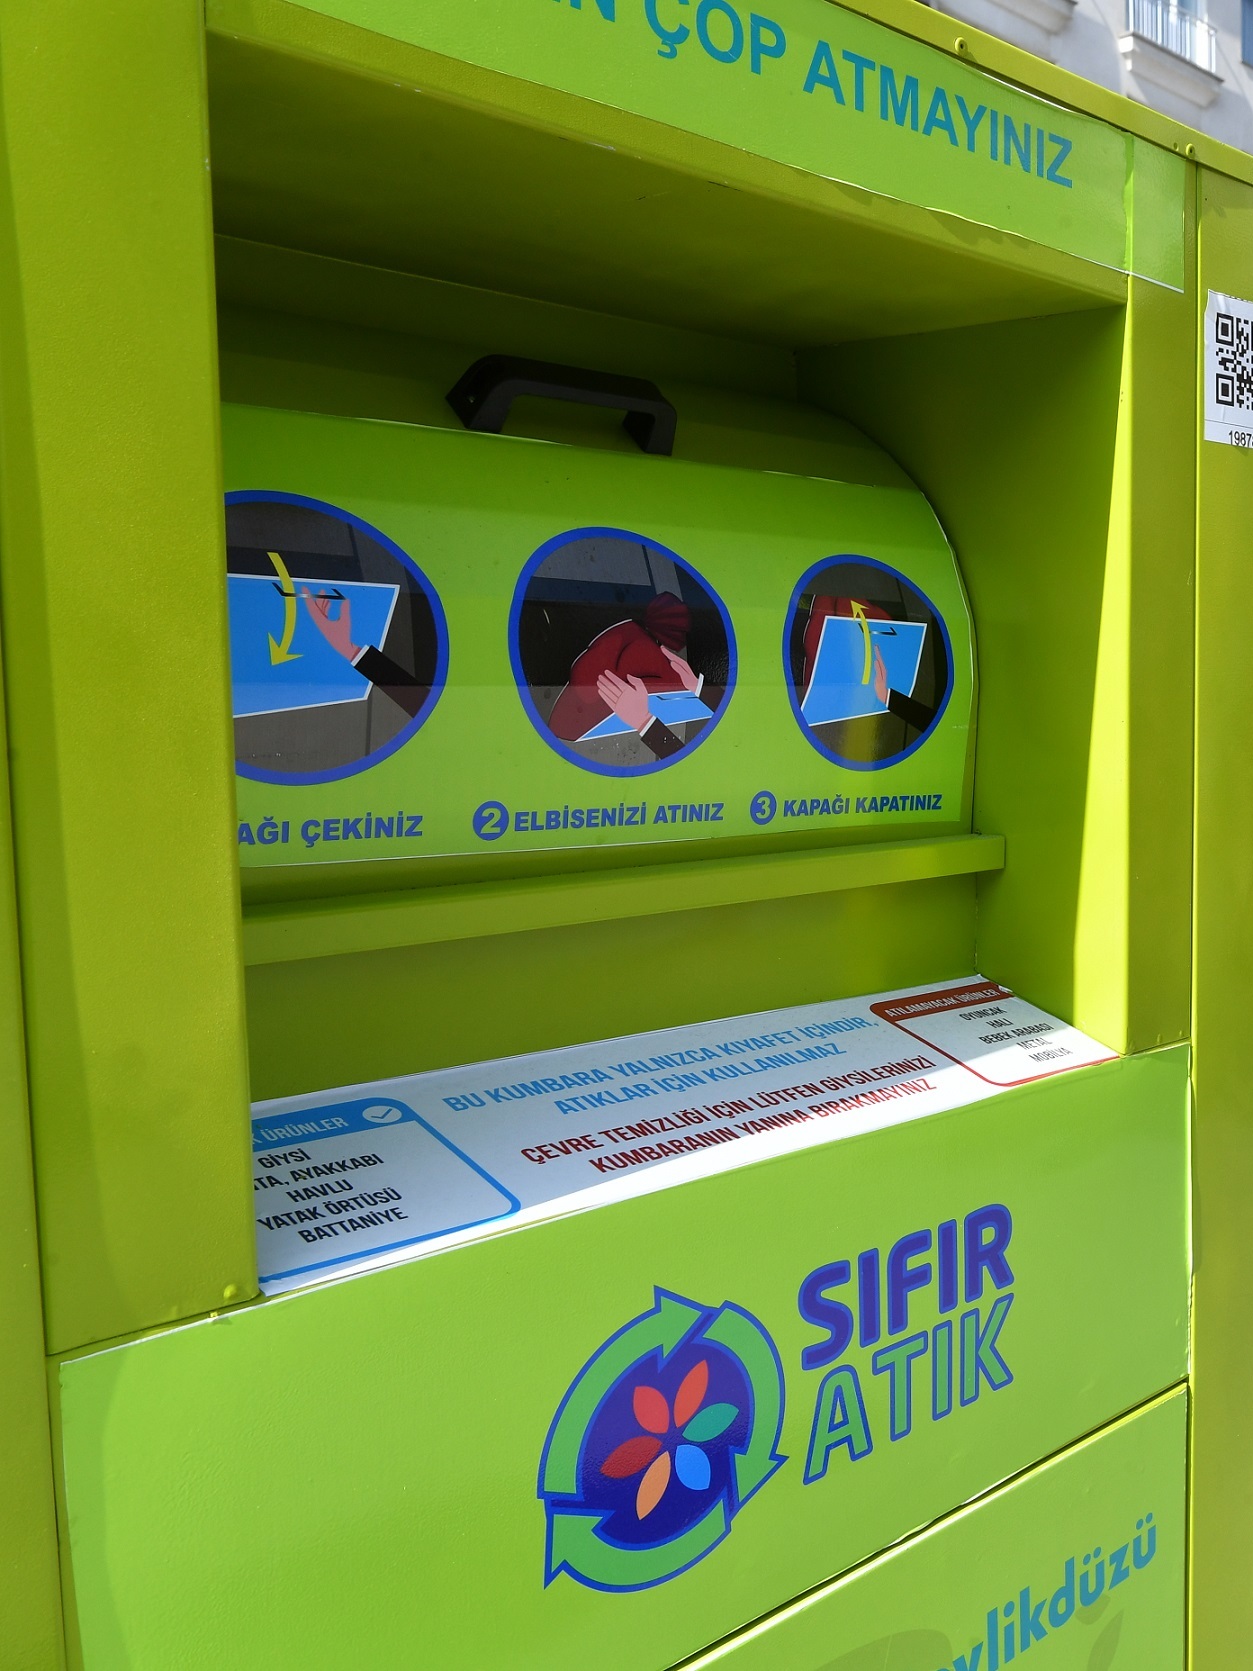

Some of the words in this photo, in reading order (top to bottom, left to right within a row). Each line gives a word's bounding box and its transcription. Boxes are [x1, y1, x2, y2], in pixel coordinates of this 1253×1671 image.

[645, 0, 787, 75] ÇOP
[802, 40, 1074, 189] ATMAYINIZ
[513, 802, 647, 832] ELBİSENİZİ
[653, 802, 725, 825] ATINIZ
[783, 793, 850, 818] KAPAĞI
[855, 794, 943, 814] KAPATINIZ
[300, 810, 424, 848] ÇEKİNİZ
[884, 996, 958, 1018] ATILAMAYACAK
[955, 988, 1001, 1005] ÜRÜNLER
[959, 1006, 1007, 1021] OYUNCAK
[978, 1031, 1016, 1045] BEBEK
[1013, 1022, 1054, 1038] ARABASI
[986, 1017, 1013, 1028] HALI
[1016, 1037, 1054, 1051] METAL
[1028, 1047, 1074, 1063] MOBİLYA
[442, 1092, 487, 1112] BU
[483, 1068, 615, 1104] KUMBARA
[607, 1046, 723, 1077] YALNIZCA
[715, 1030, 801, 1056] KIYAFET
[796, 1015, 879, 1040] İÇİNDİR,
[553, 1083, 660, 1115] ATIKLAR
[650, 1070, 711, 1094] İÇİN
[701, 1042, 848, 1082] KULLANILMAZ
[520, 1134, 605, 1165] ÇEVRE
[598, 1105, 712, 1144] TEMİZLİĞİ
[702, 1095, 753, 1120] İÇİN
[747, 1081, 827, 1110] LÜTFEN
[821, 1054, 938, 1091] GİYSİLERİNİZİ
[260, 1116, 350, 1142] ÜRÜNLER
[588, 1126, 742, 1174] KUMBARANIN
[733, 1108, 813, 1136] YANINA
[807, 1077, 938, 1118] BIRAKMAYINIZ
[257, 1147, 312, 1169] GİYSİ
[289, 1152, 385, 1183] AYAKKABI
[285, 1178, 354, 1203] HAVLU
[256, 1205, 328, 1232] YATAK
[322, 1186, 403, 1215] ÖRTÜSÜ
[297, 1206, 409, 1243] BATTANİYE
[797, 1202, 1015, 1371] SIFIR
[802, 1292, 1015, 1486] ATIK
[936, 1511, 1157, 1671] ylikdüzü
